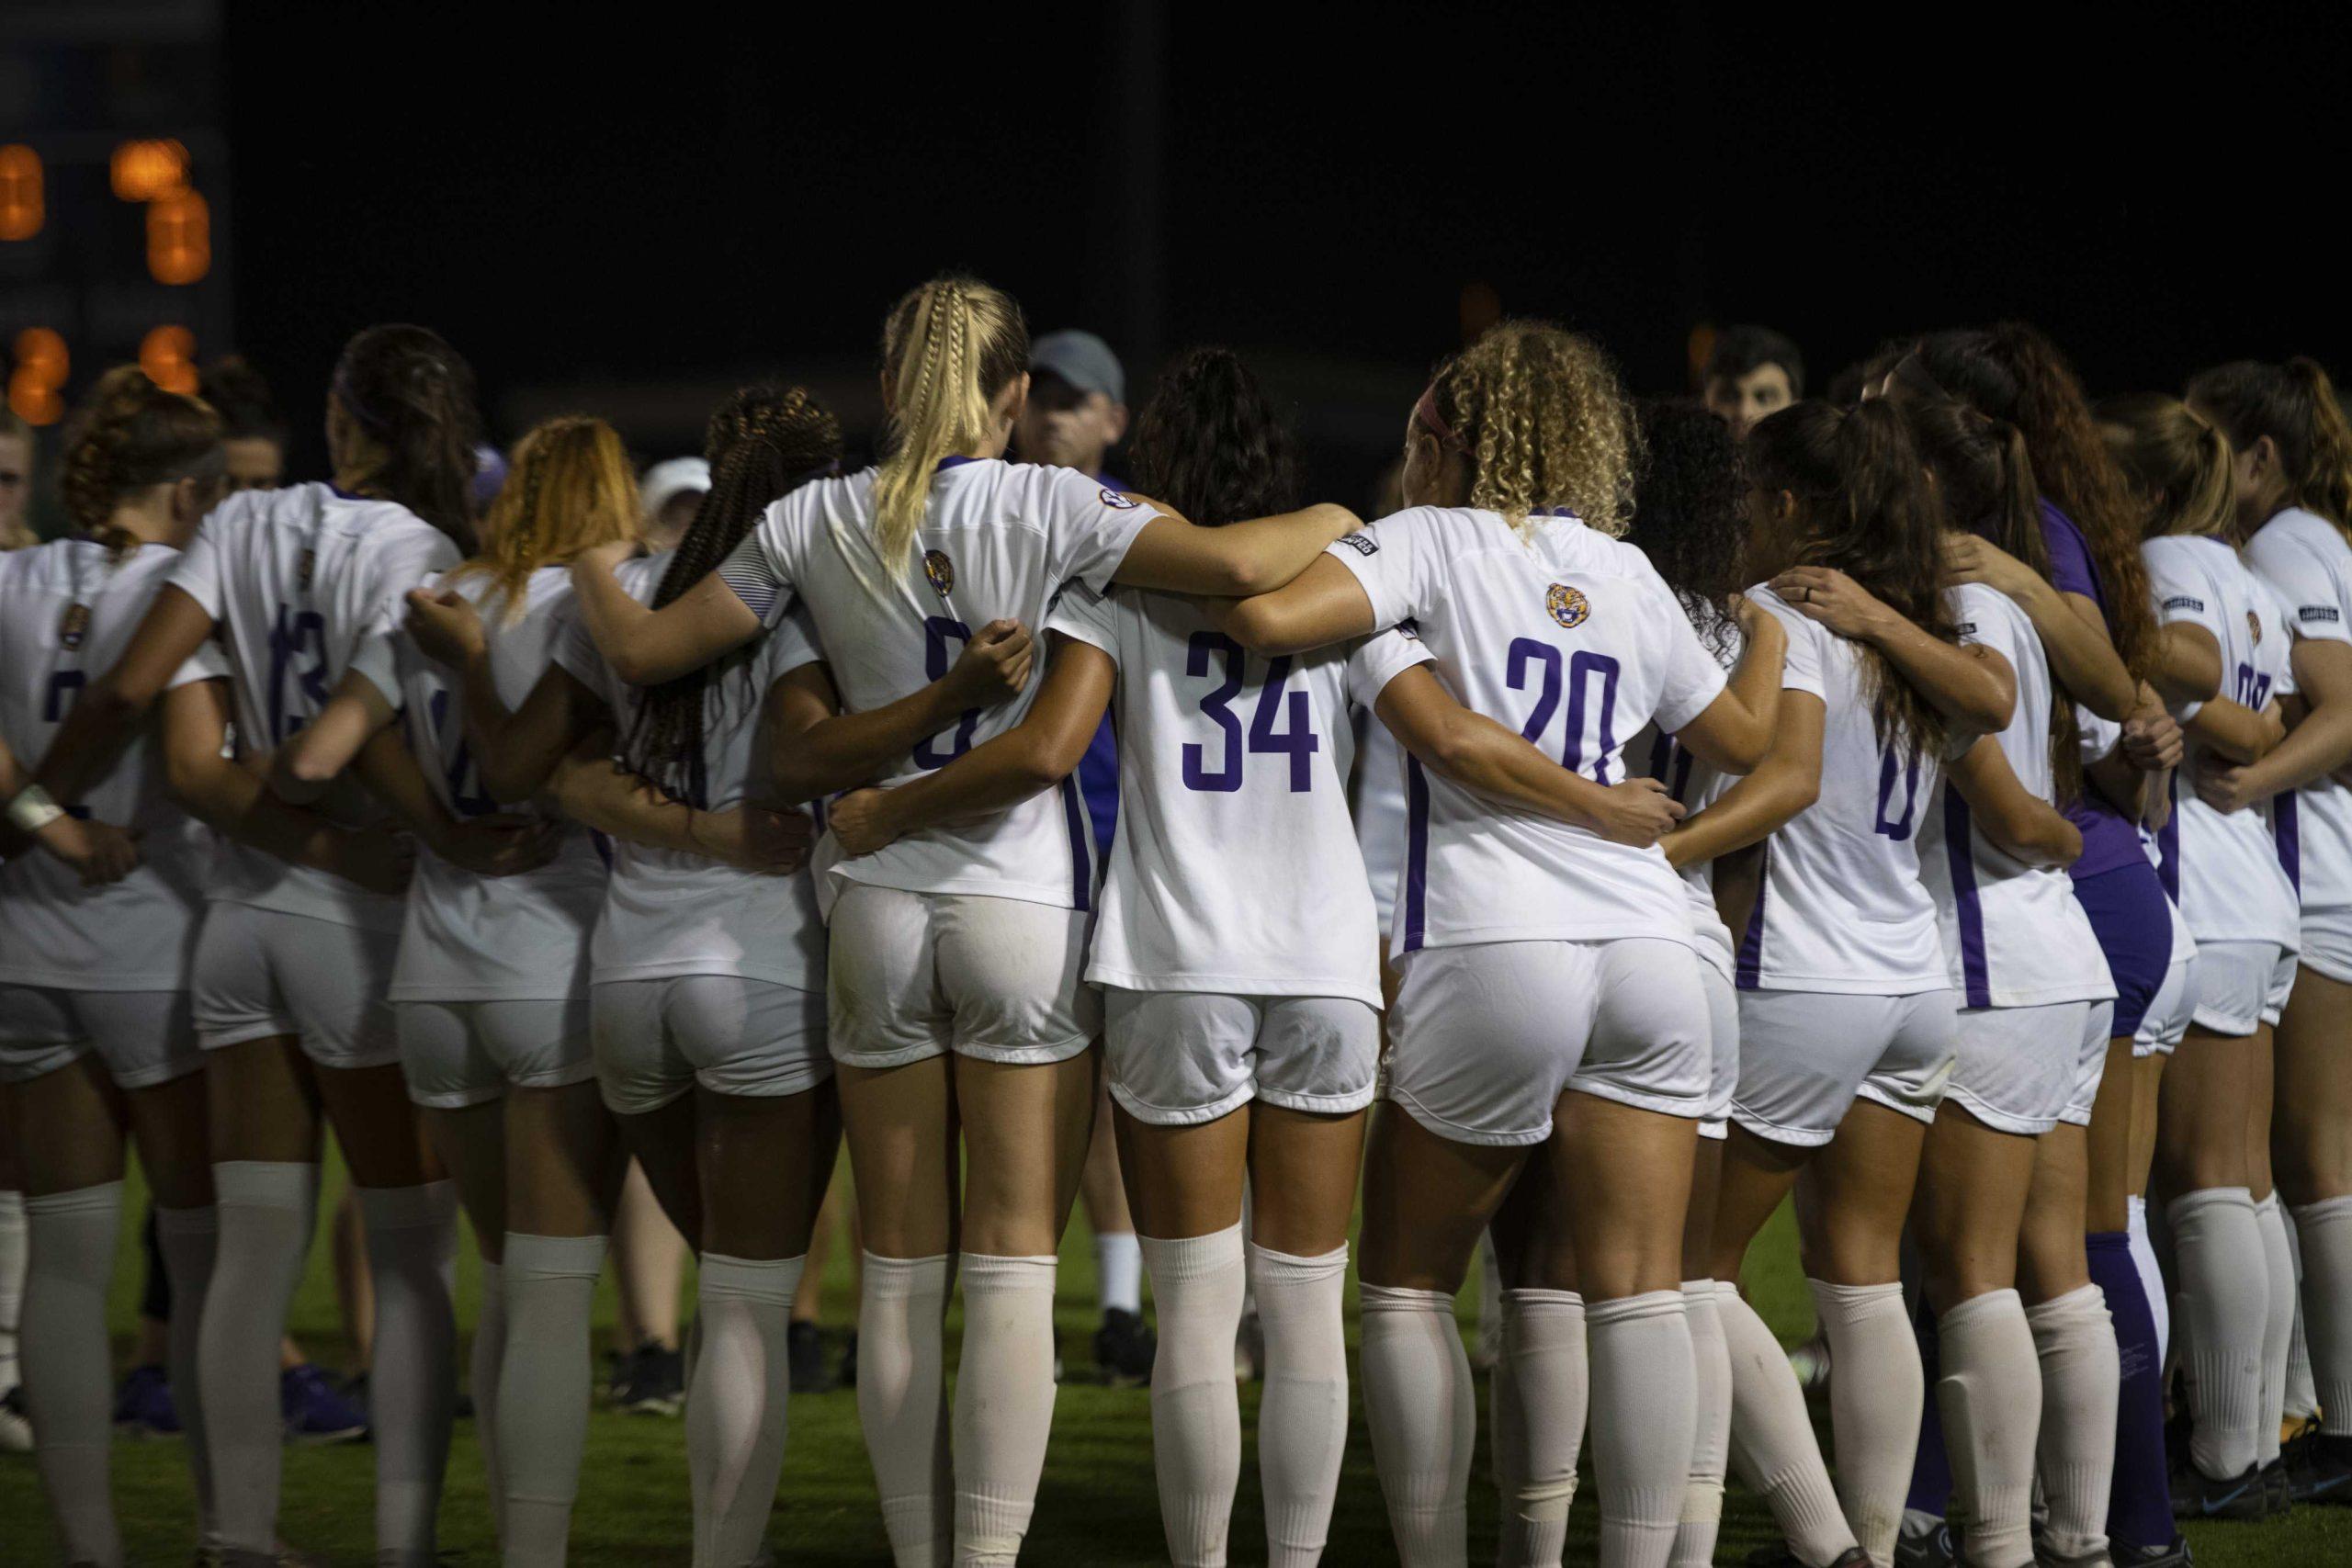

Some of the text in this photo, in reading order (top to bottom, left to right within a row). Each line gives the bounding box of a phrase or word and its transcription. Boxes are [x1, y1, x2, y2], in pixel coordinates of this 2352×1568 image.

[269, 604, 328, 745] 13
[1182, 631, 1318, 792] 34
[1507, 637, 1620, 787] 20
